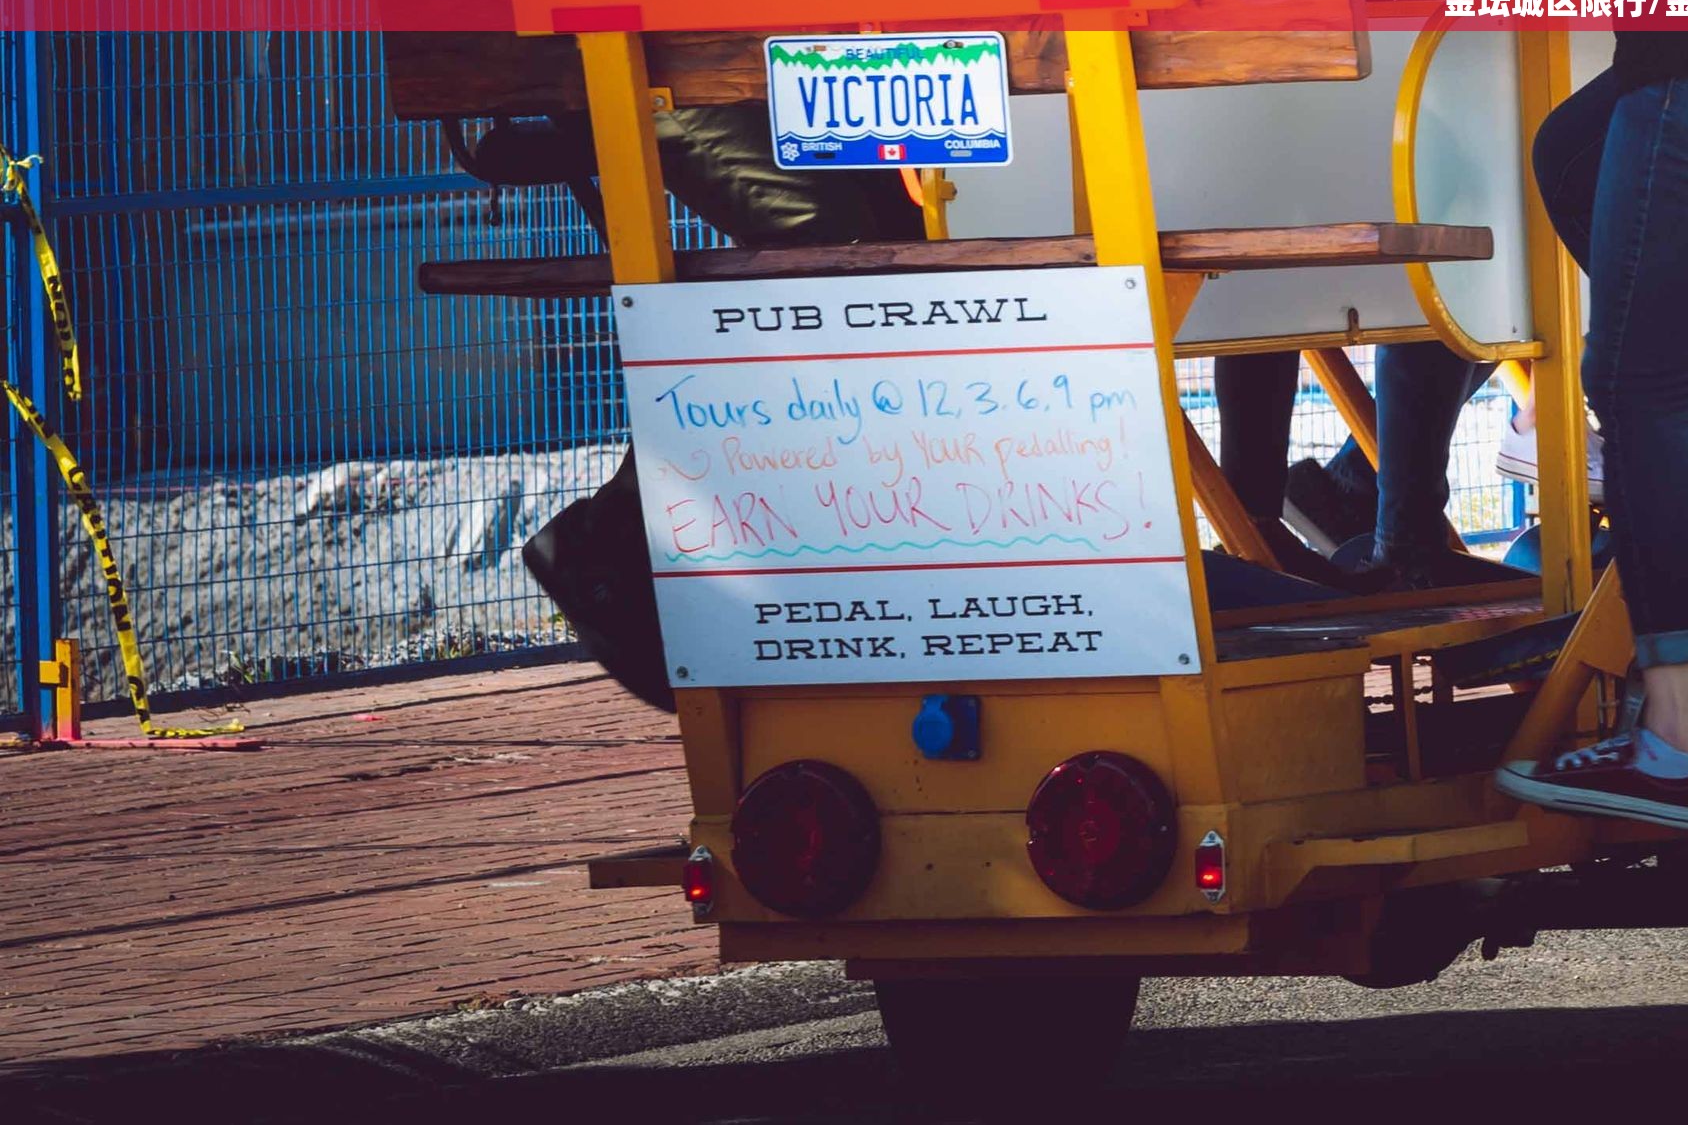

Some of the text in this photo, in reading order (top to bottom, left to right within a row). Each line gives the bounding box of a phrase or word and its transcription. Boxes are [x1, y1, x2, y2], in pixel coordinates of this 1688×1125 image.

[846, 47, 925, 61] BEAUTIFUL
[798, 73, 979, 128] VICTORIA
[802, 139, 1001, 151] BRITISH COLUMBIA
[712, 297, 1048, 333] PUB CRAWL
[655, 374, 772, 429] Tours
[788, 377, 862, 445] daily
[872, 379, 903, 415] @
[1089, 389, 1137, 423] pm
[722, 435, 838, 476] Powered
[862, 435, 905, 488] by
[665, 487, 798, 553] EARN
[815, 476, 952, 537] YOUR
[755, 593, 1094, 625] PEDAL, LAUGH,
[754, 630, 1103, 662] DRINK, REPEAT
